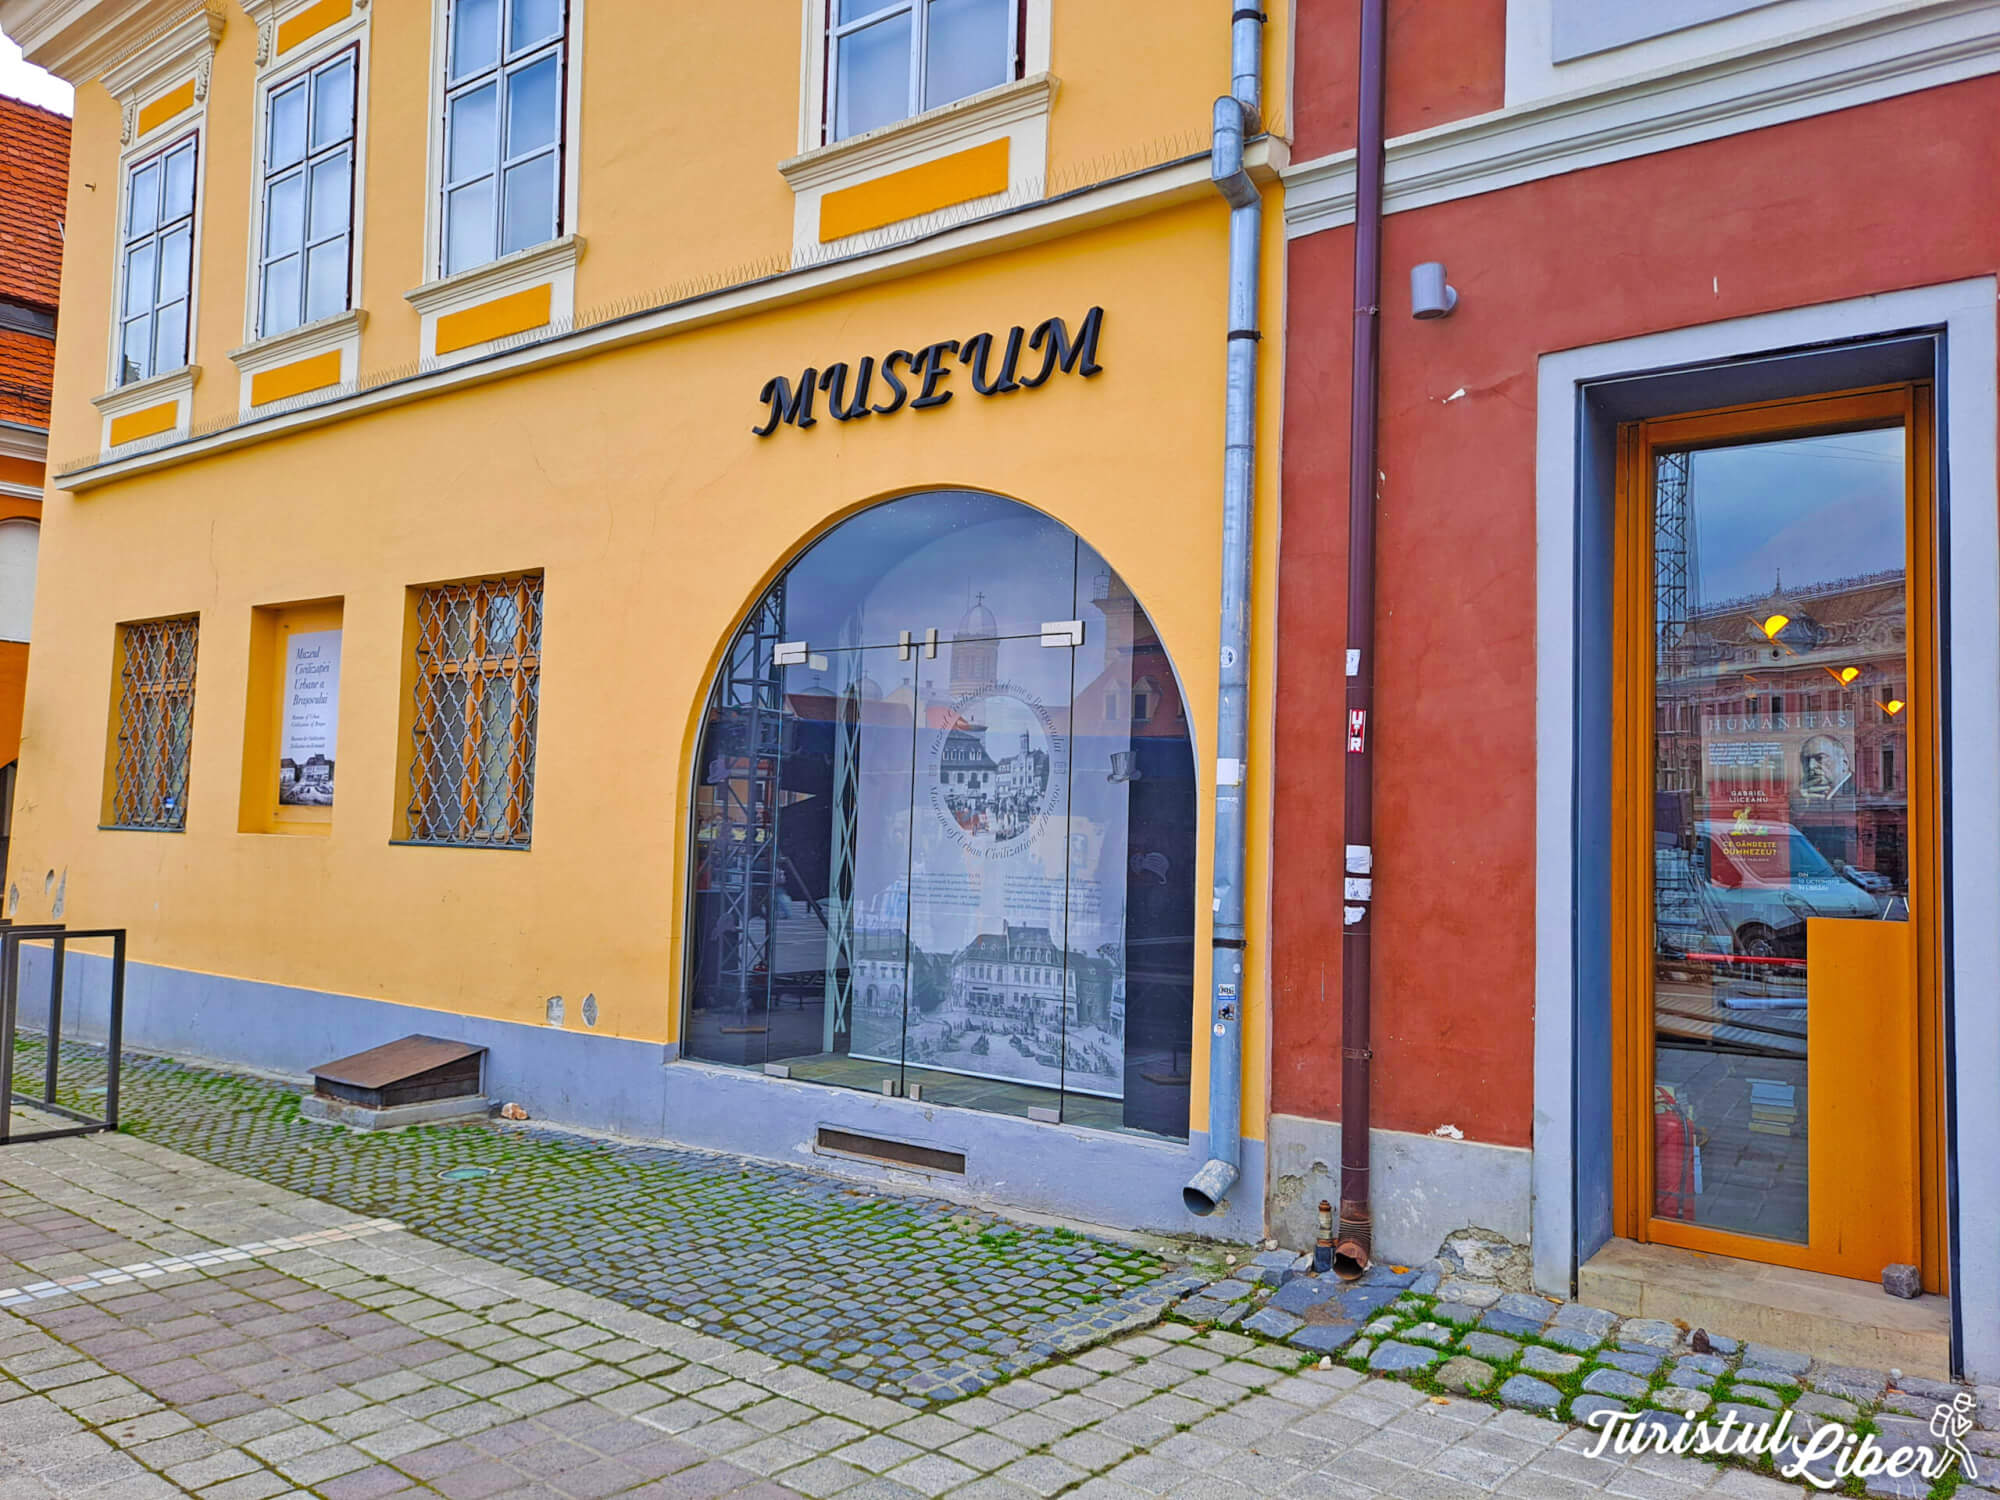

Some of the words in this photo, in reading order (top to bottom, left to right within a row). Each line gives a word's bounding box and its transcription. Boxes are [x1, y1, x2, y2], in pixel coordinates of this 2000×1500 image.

[751, 305, 1105, 438] MUSEUM
[1708, 714, 1848, 731] HUMANITAS
[929, 785, 948, 827] Museum
[985, 837, 1036, 859] Civilization
